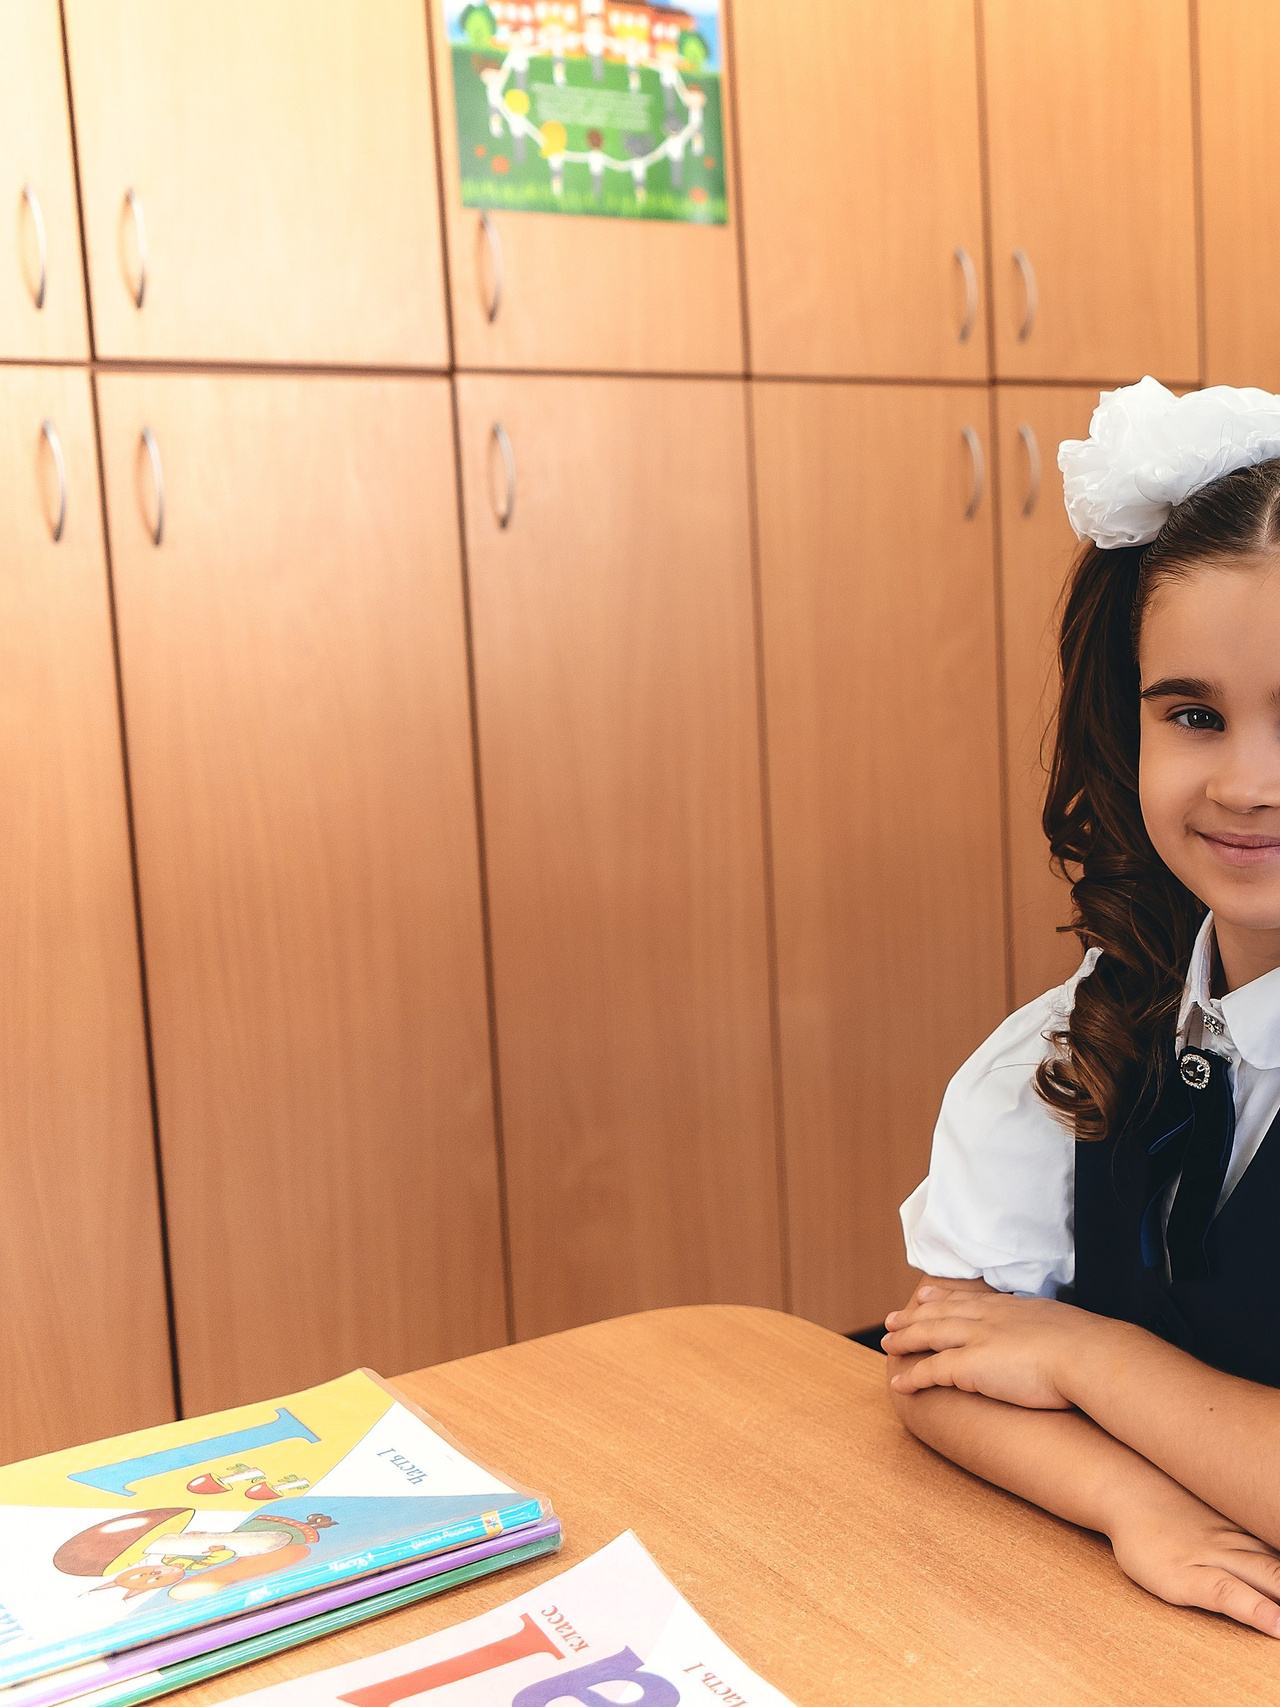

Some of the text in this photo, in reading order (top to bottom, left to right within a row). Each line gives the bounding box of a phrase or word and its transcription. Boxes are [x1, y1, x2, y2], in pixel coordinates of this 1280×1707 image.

[67, 1407, 321, 1497] 1
[376, 1447, 428, 1485] Часть 1
[541, 1605, 590, 1652] класс
[336, 1612, 566, 1707] 1
[682, 1661, 705, 1674] 1
